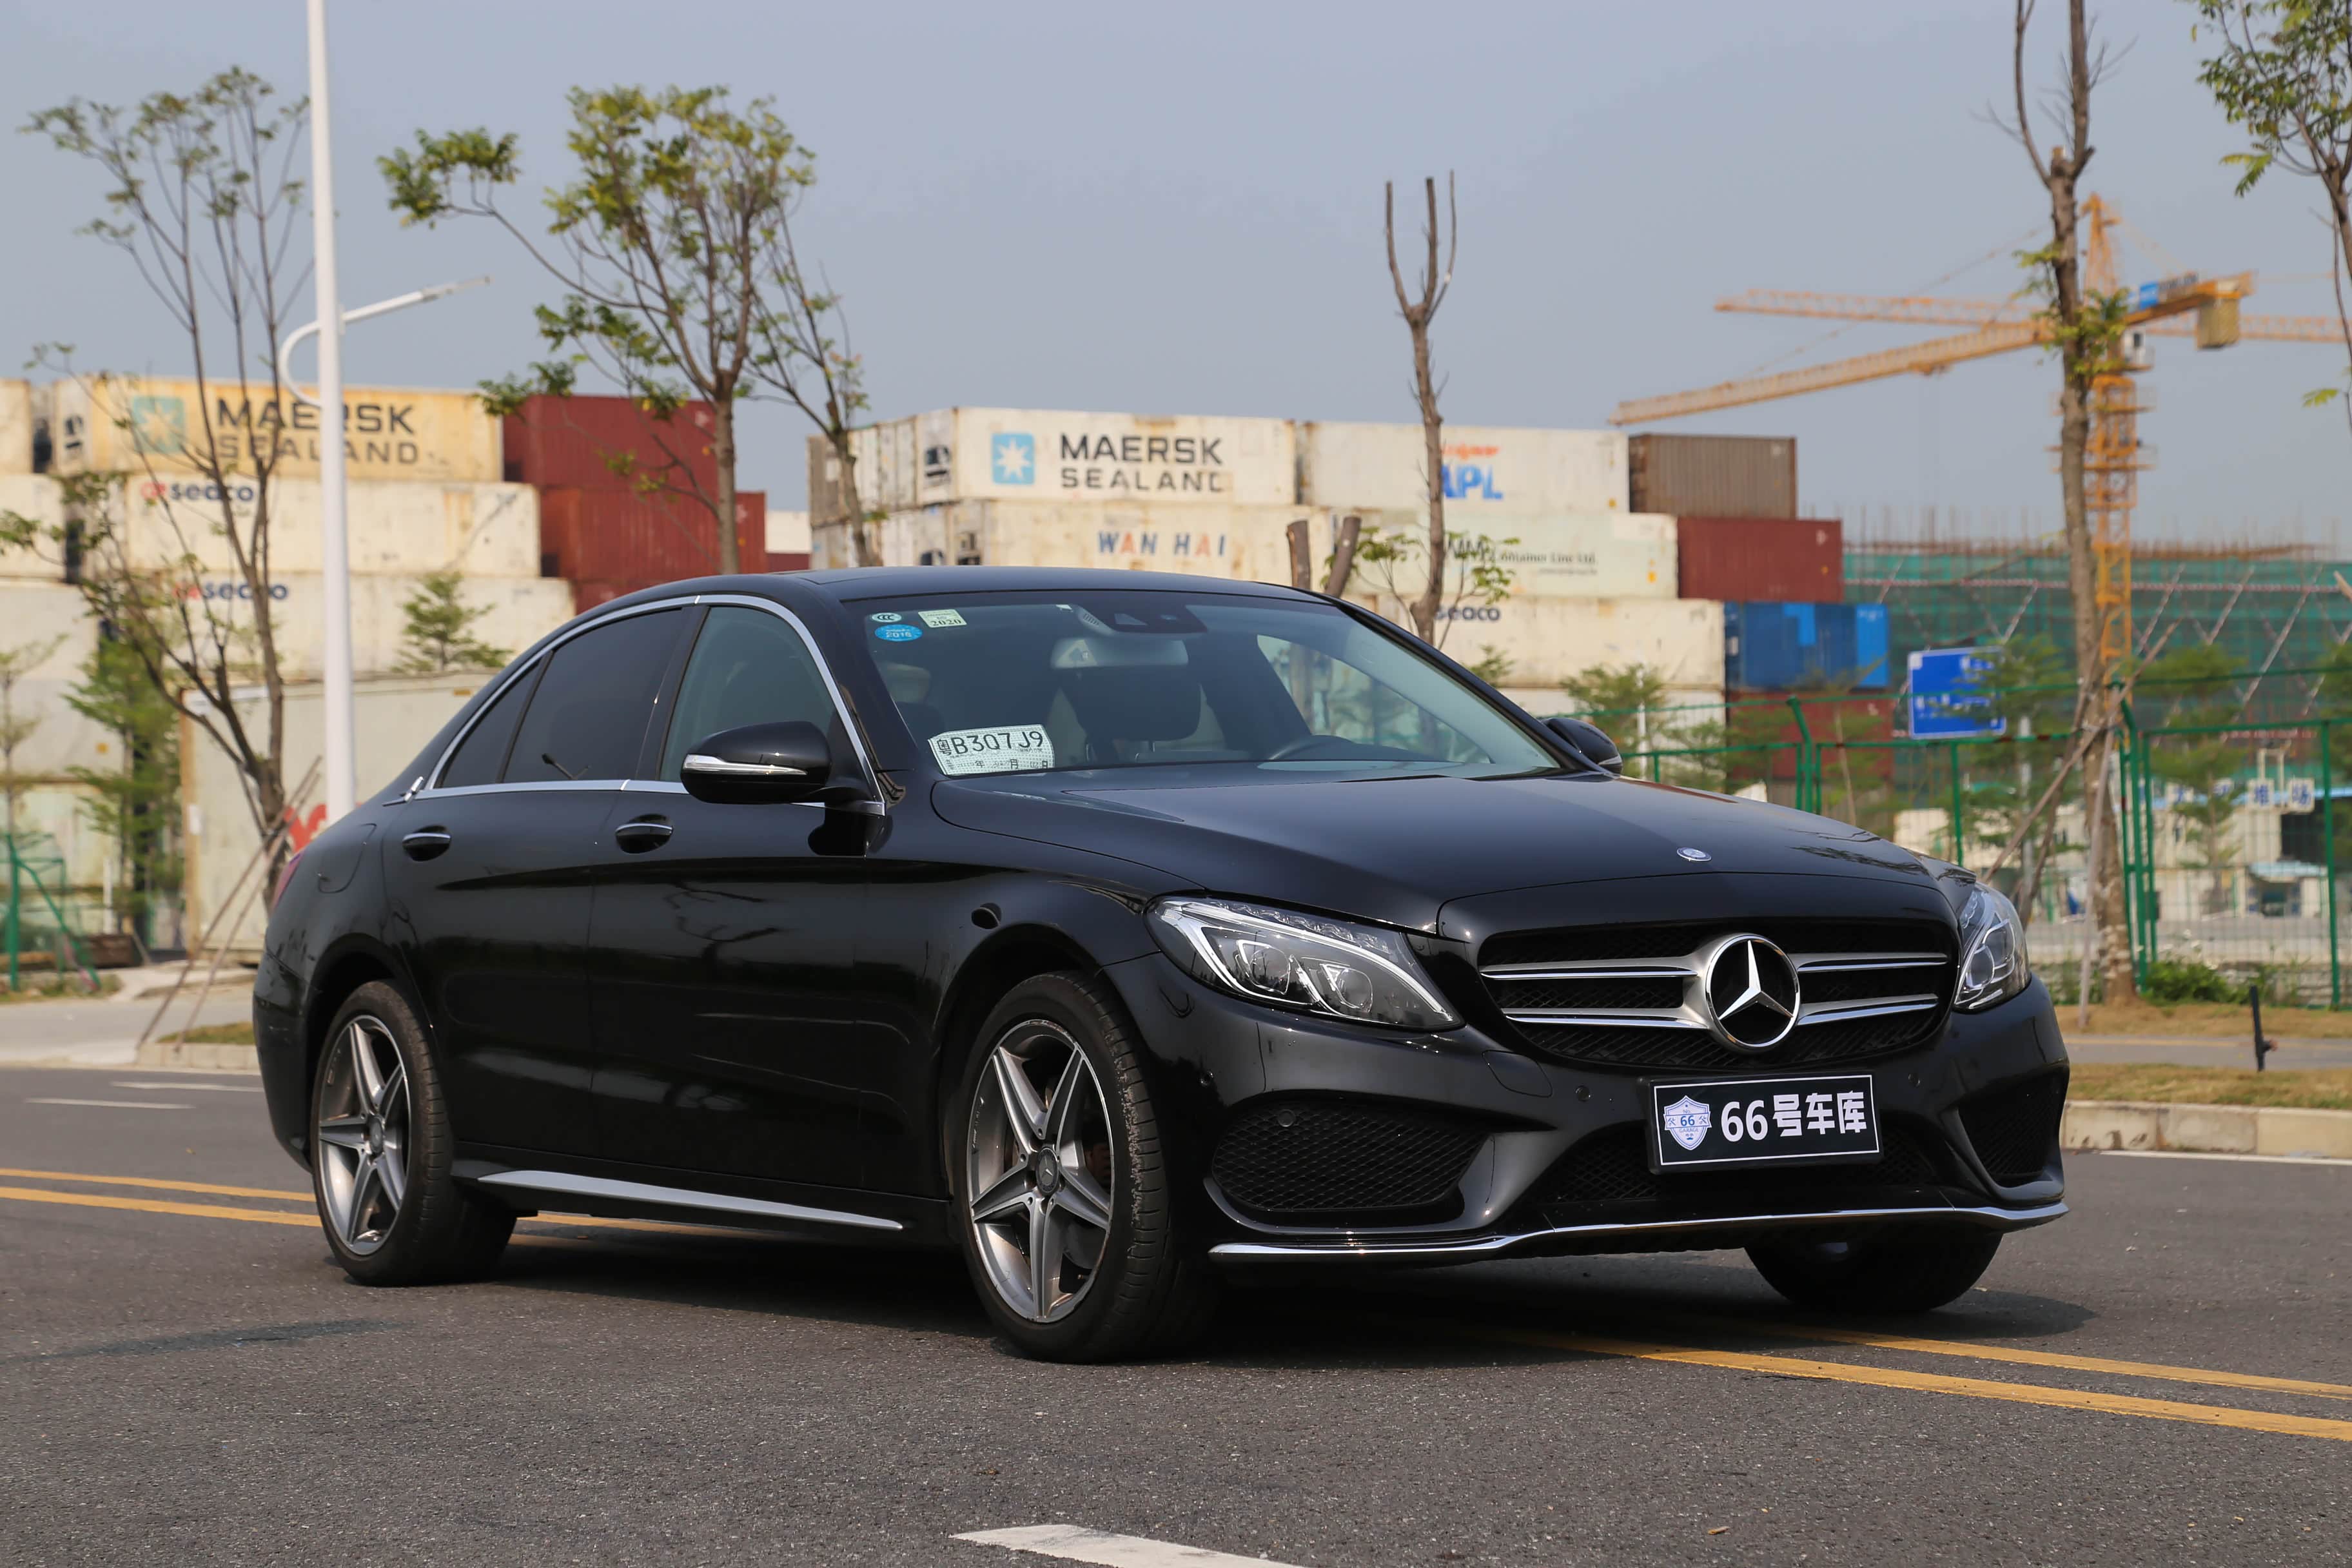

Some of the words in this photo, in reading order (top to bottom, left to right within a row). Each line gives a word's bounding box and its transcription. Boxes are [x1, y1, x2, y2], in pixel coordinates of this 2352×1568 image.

[218, 398, 414, 434] MAESK
[1061, 433, 1223, 464] MAERSK
[1099, 530, 1158, 554] WAN
[1173, 533, 1227, 557] HAI
[204, 582, 288, 600] seao
[930, 618, 962, 627] 2020
[1680, 1115, 1695, 1126] 66
[1721, 1091, 1867, 1142] 66号车库
